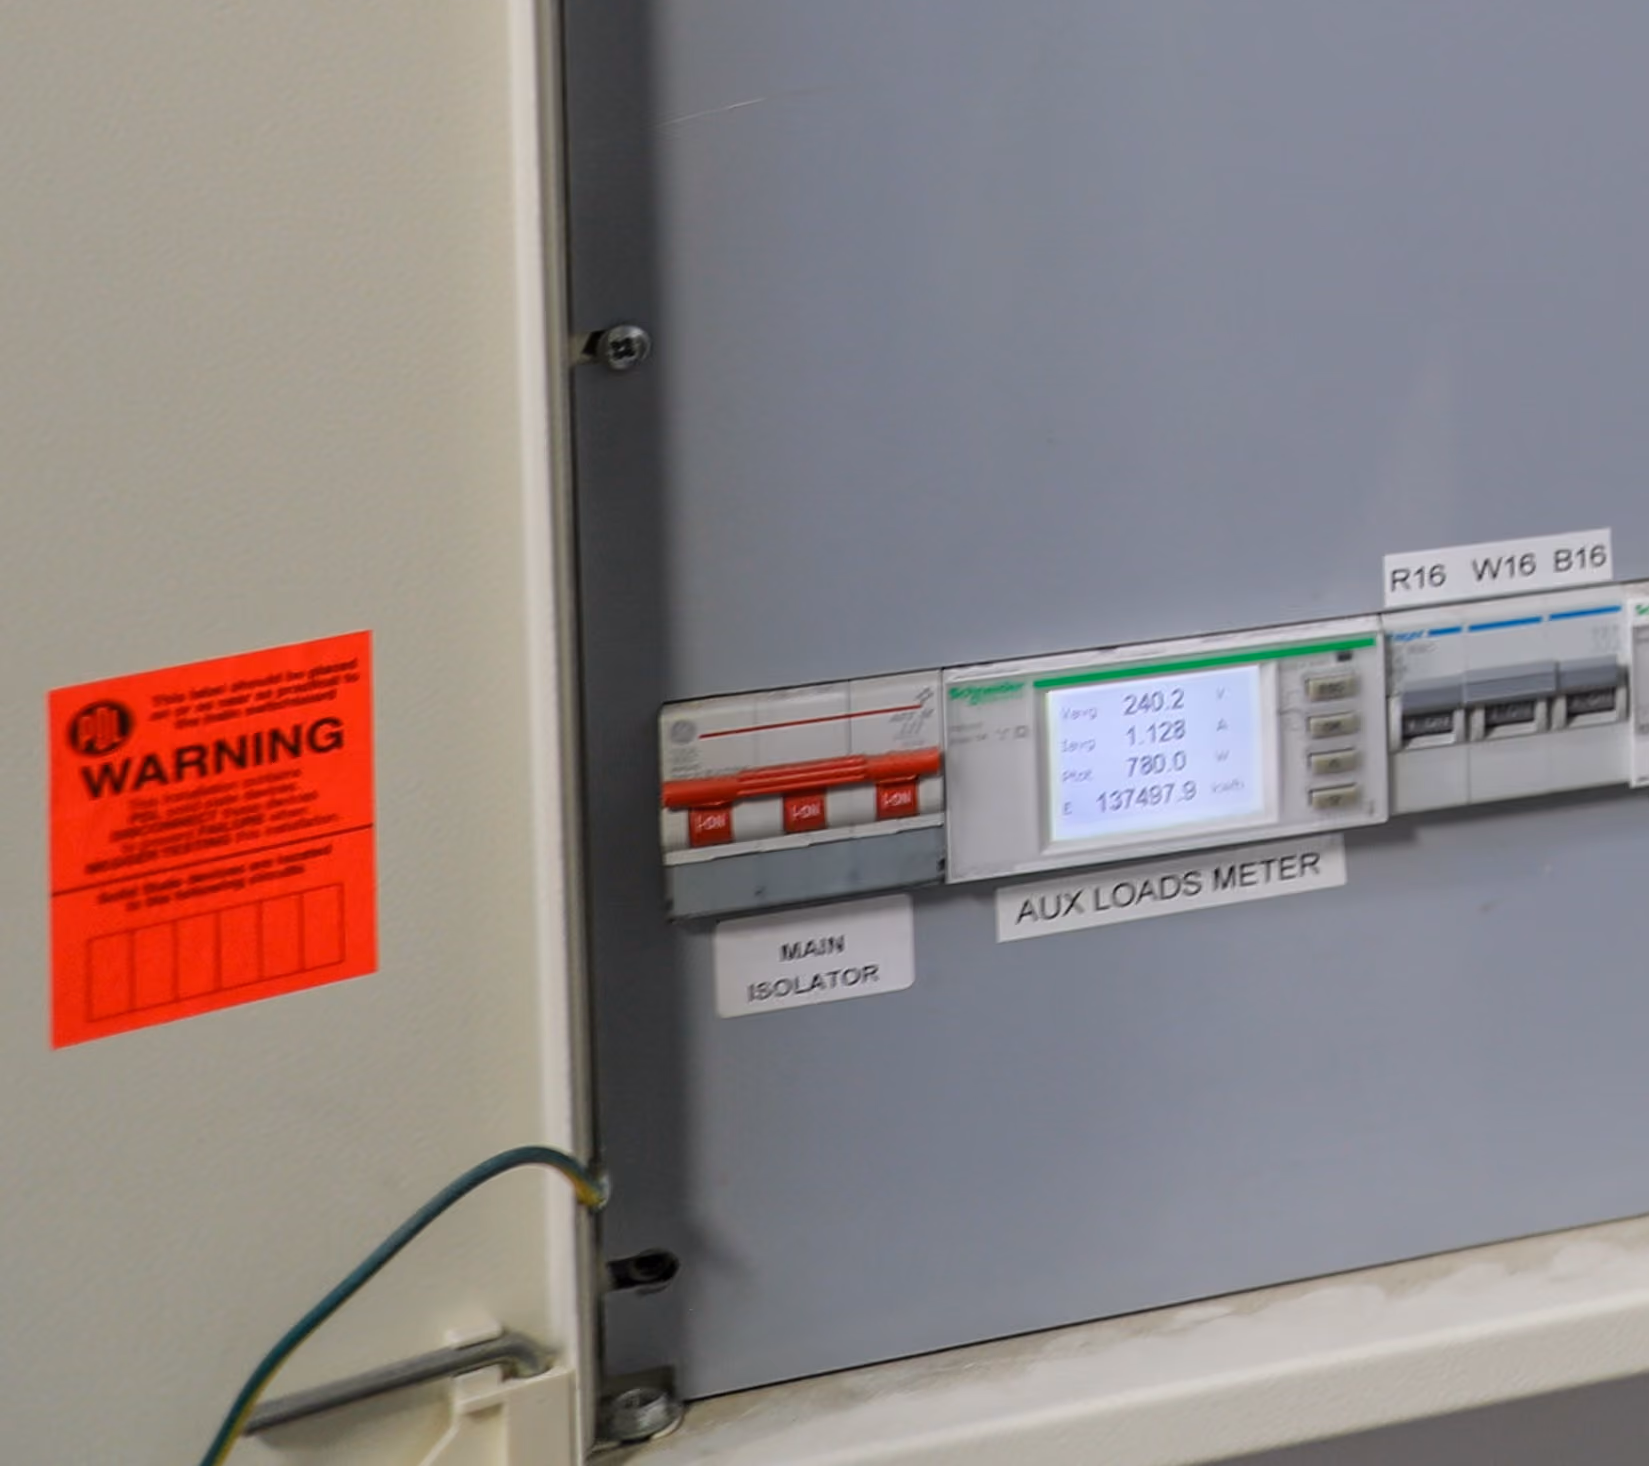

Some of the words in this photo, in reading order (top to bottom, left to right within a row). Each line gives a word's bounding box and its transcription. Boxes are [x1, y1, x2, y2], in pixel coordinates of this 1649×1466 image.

[1391, 563, 1447, 592] R16
[1472, 552, 1537, 582] W16
[1553, 544, 1607, 573] B16
[1123, 687, 1185, 717] 240.2
[1126, 720, 1186, 747] 1.128
[81, 717, 345, 801] WARNING
[1016, 889, 1084, 924] AUX
[1093, 873, 1203, 912] LOADS
[1213, 851, 1321, 891] METER
[780, 935, 845, 961] MAIN
[747, 964, 880, 1003] ISOLATOR
